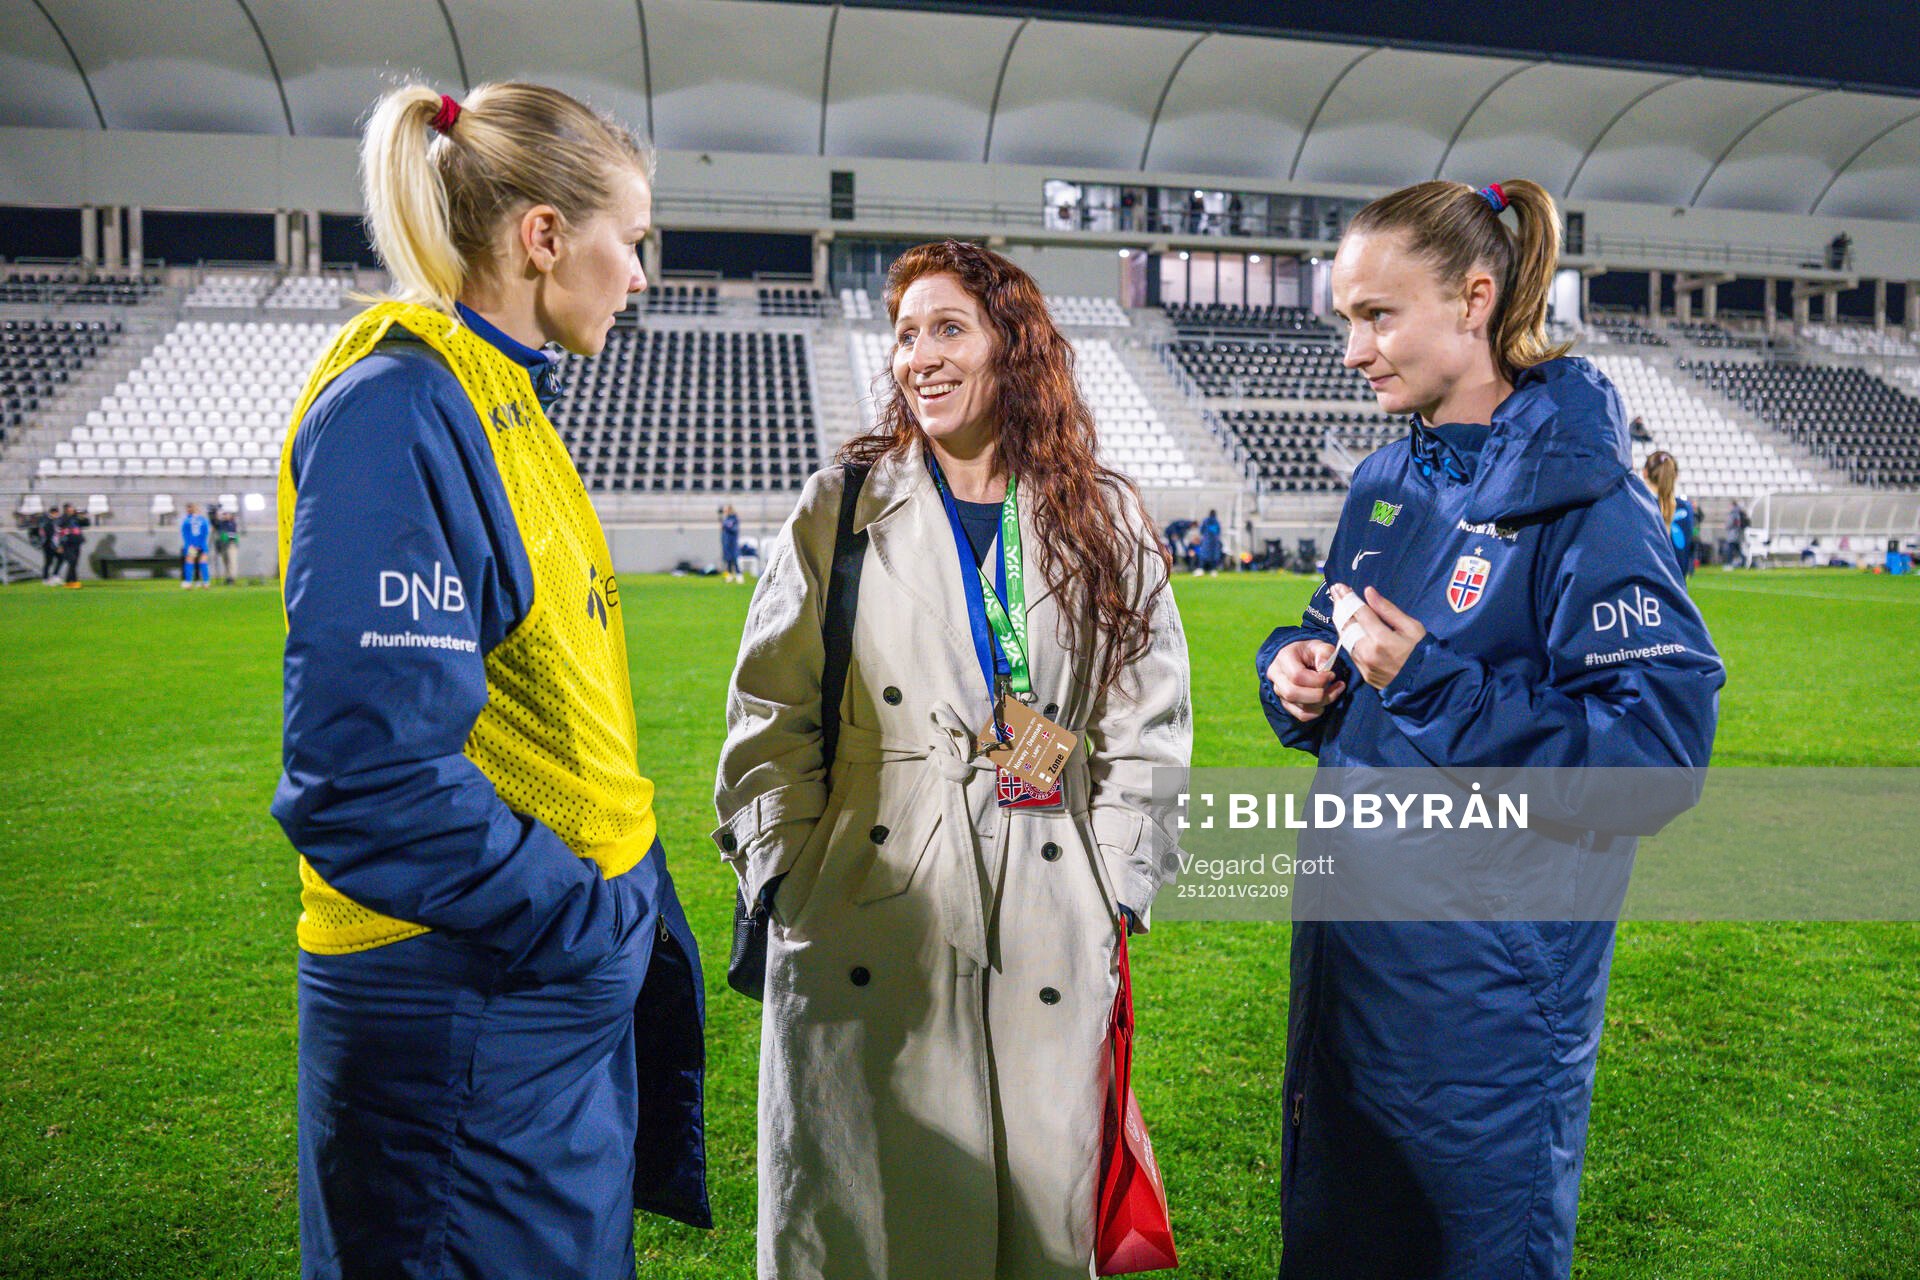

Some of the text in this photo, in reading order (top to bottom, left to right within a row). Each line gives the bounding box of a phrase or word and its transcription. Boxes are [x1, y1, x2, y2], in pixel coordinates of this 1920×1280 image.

[380, 561, 465, 620] DNB
[1592, 586, 1661, 638] DNB
[360, 631, 478, 653] #huninvesterer
[1056, 742, 1069, 752] 1
[1048, 753, 1065, 775] Zone
